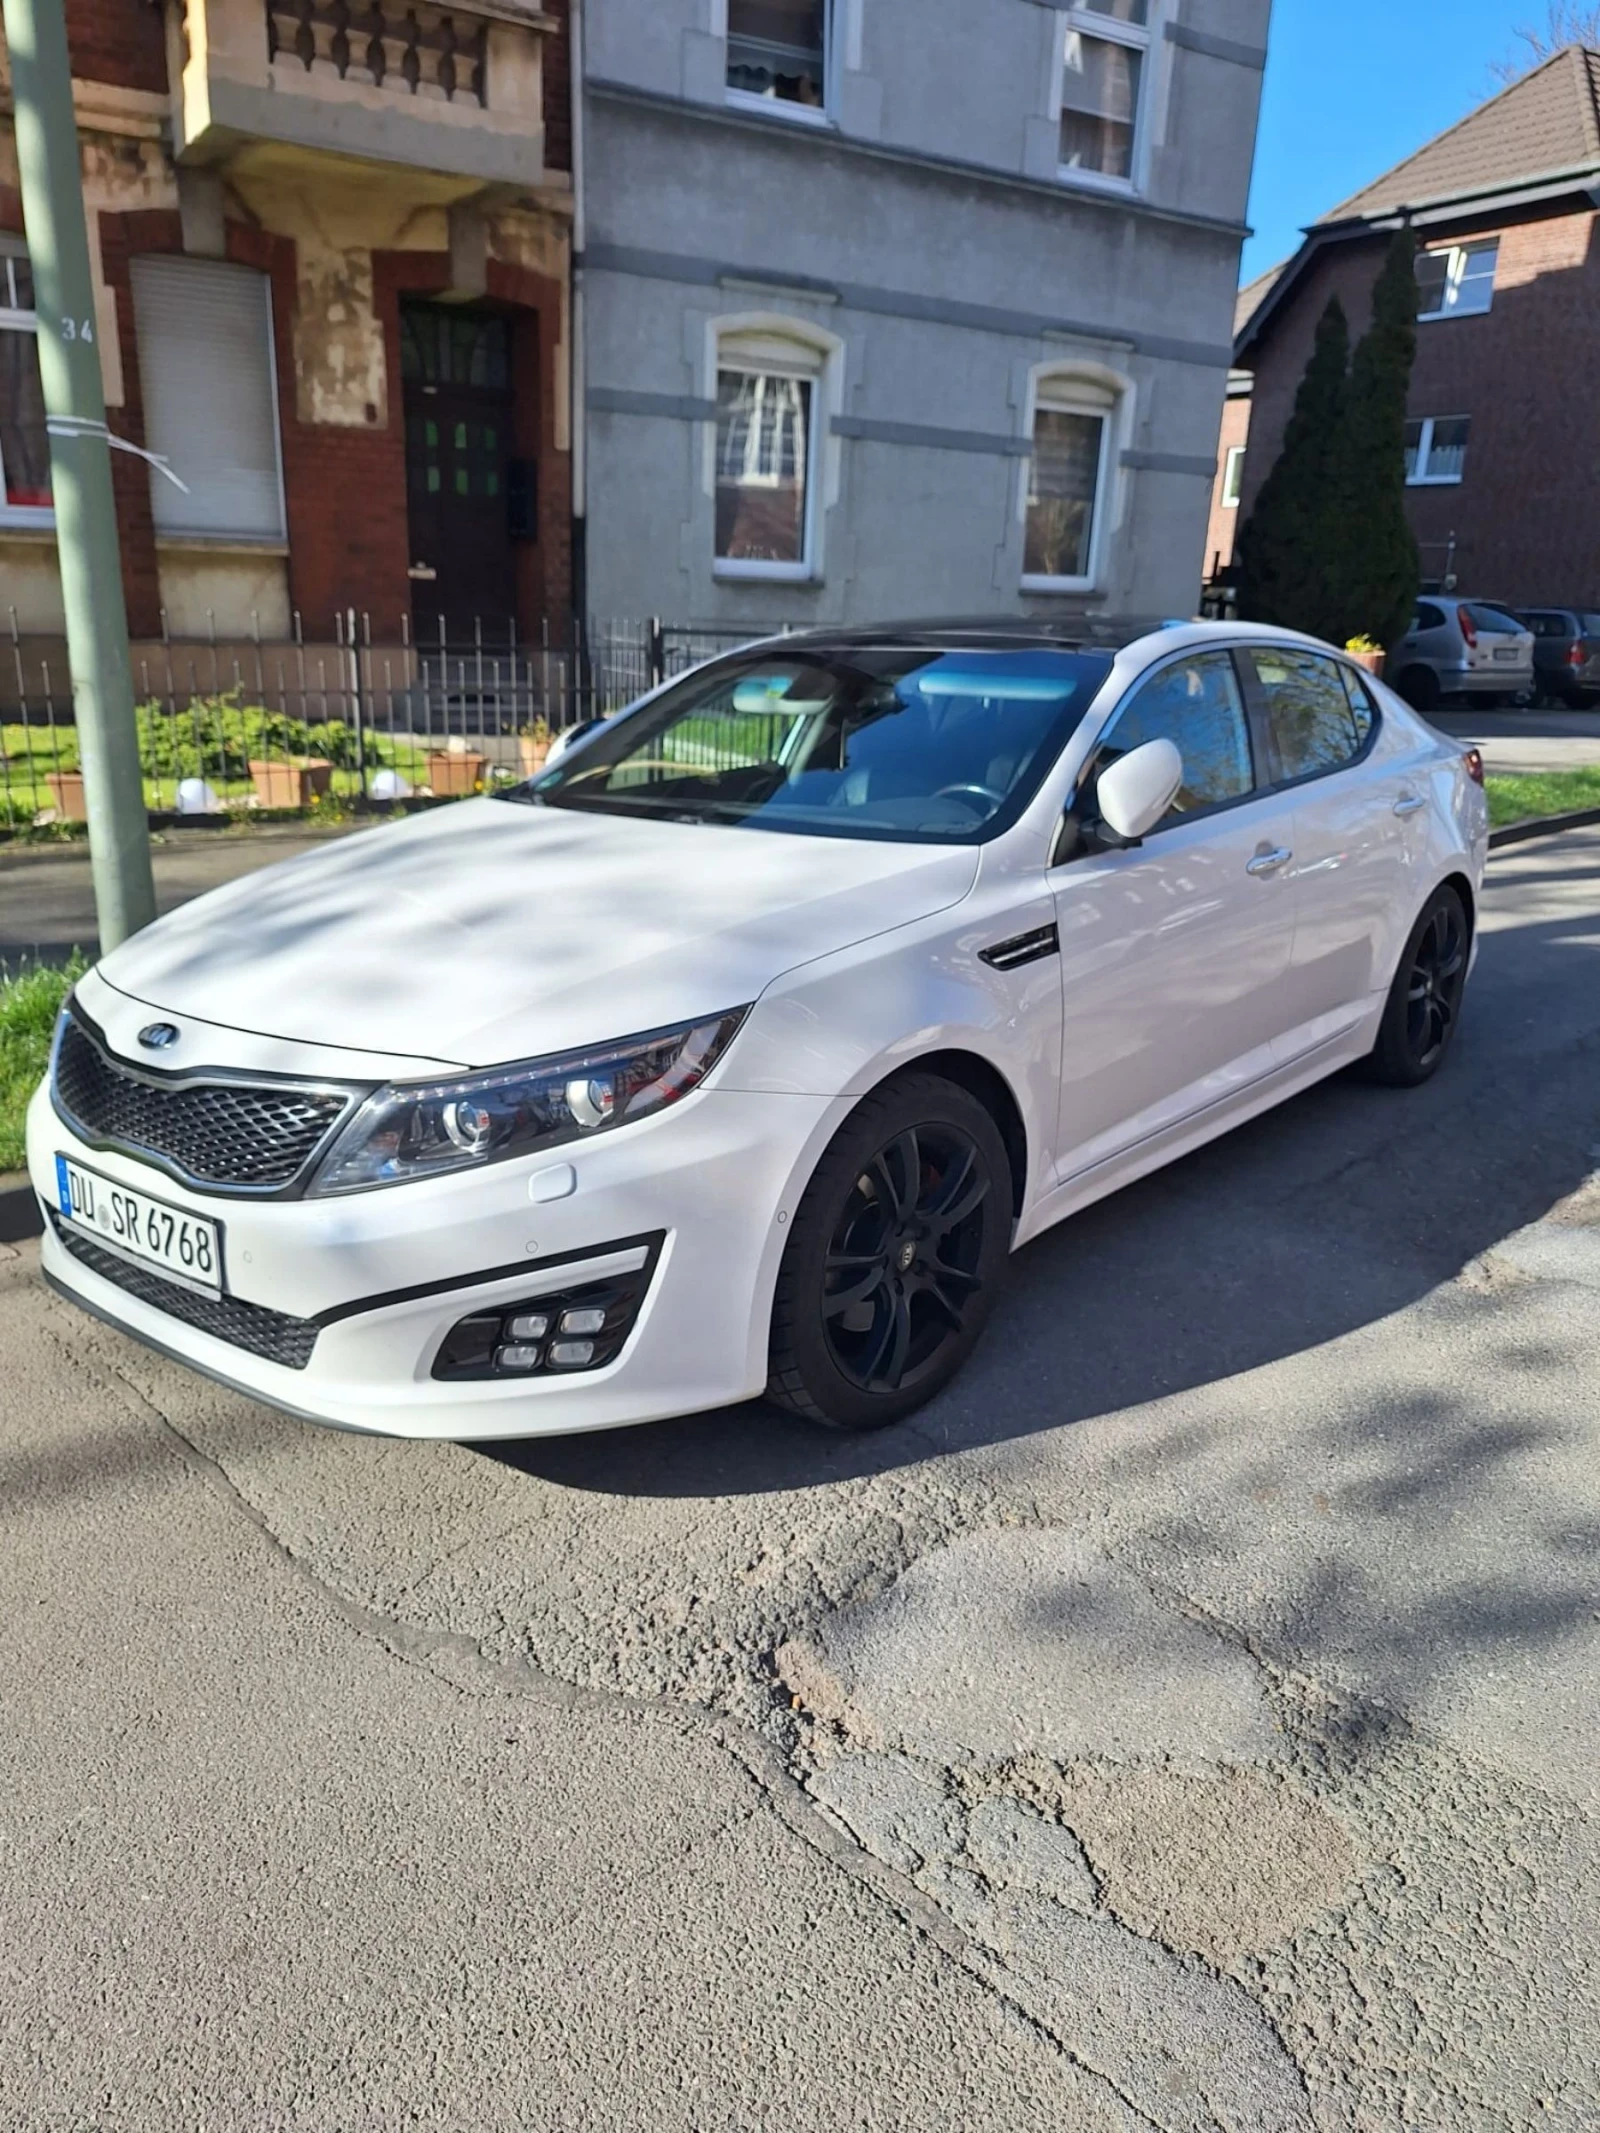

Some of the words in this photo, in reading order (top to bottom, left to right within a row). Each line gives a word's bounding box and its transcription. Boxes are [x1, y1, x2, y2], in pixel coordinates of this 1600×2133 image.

[61, 316, 93, 344] 34
[69, 1170, 96, 1222] DU
[111, 1191, 141, 1245] SR
[147, 1207, 212, 1273] 6768
